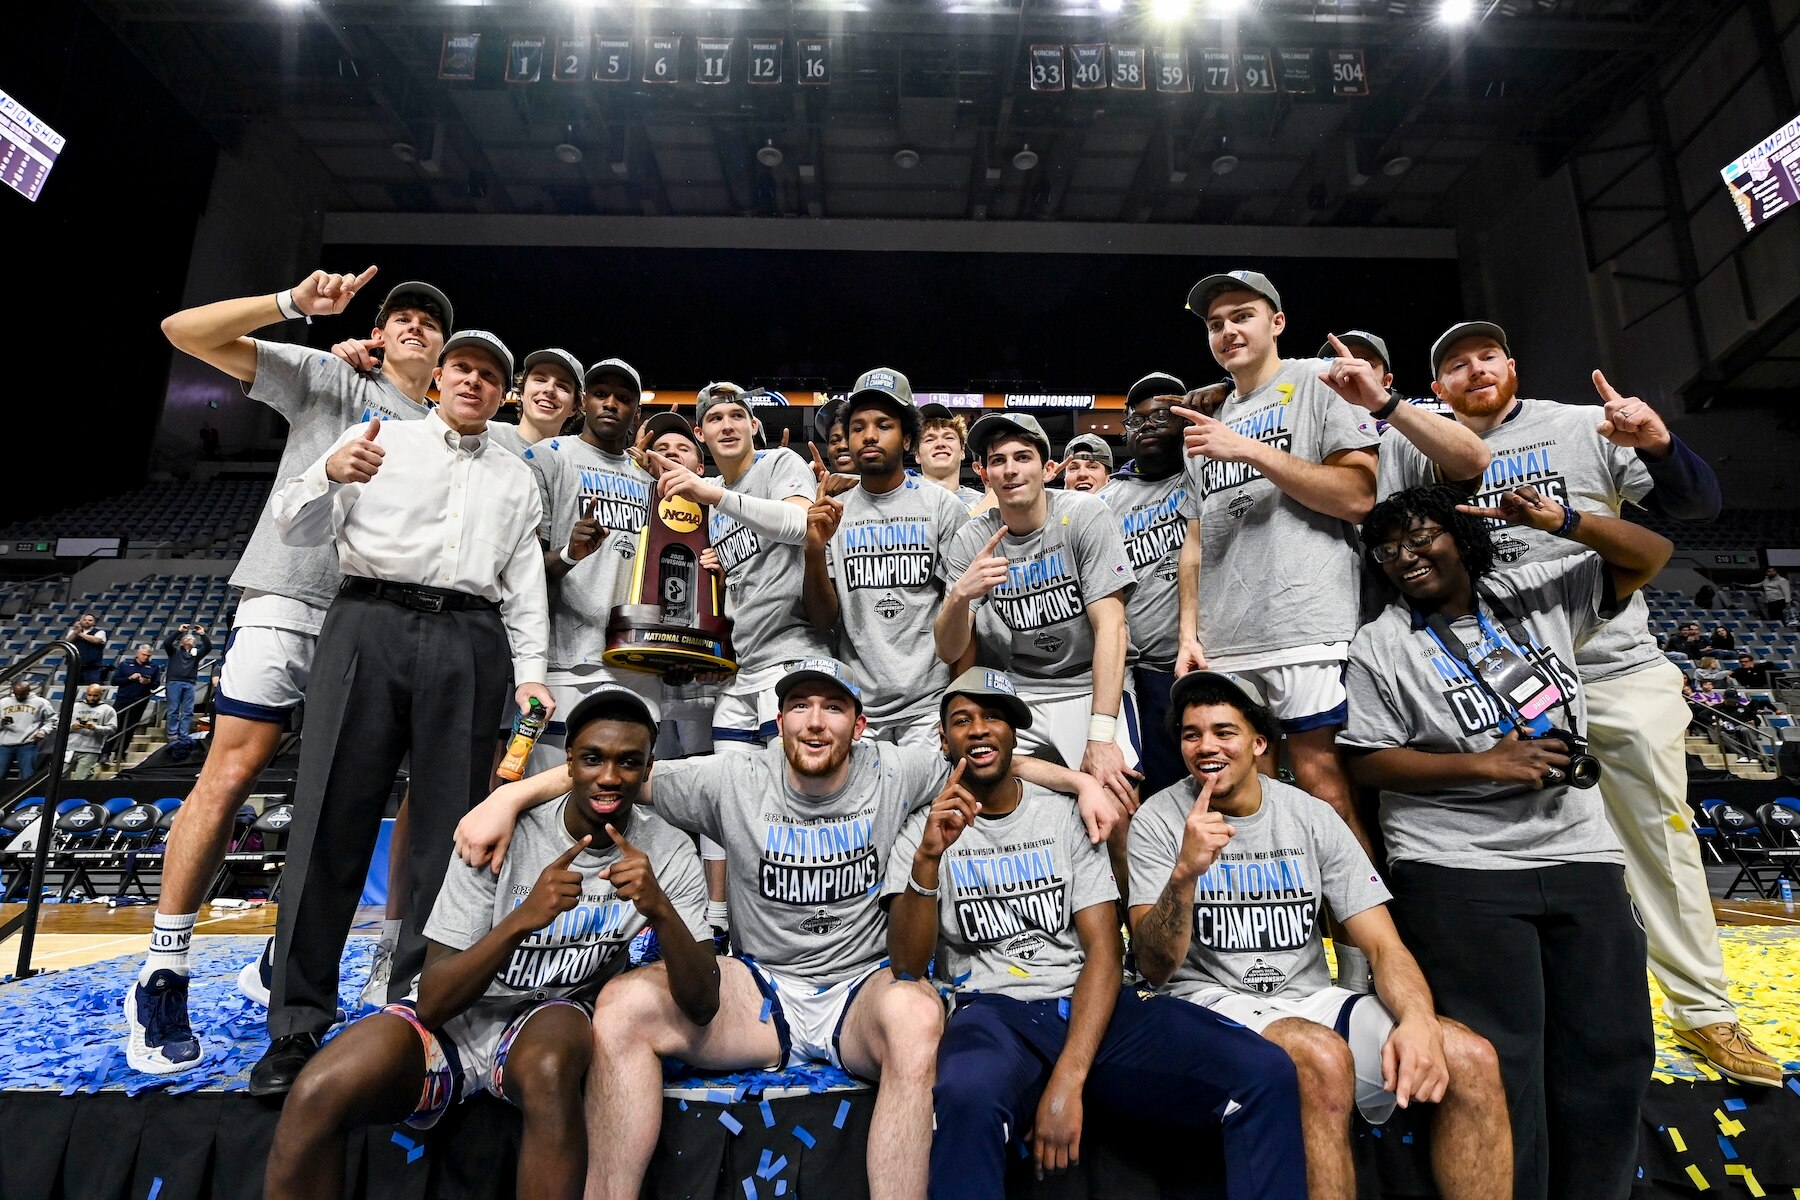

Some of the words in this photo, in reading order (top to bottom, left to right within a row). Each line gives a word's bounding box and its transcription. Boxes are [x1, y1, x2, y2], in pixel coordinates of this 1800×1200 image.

[519, 57, 528, 75] 1
[565, 55, 578, 73] 2
[608, 55, 620, 73] 5
[655, 57, 667, 76] 6
[704, 57, 724, 76] 11
[754, 58, 774, 77] 12
[806, 58, 825, 78] 16
[1076, 63, 1100, 82] 40
[1117, 63, 1139, 82] 58
[1333, 63, 1363, 82] 504
[1034, 65, 1060, 83] 33
[1162, 67, 1183, 85] 59
[1207, 67, 1230, 86] 77
[1246, 68, 1271, 88] 91
[870, 379, 895, 389] CHAMPIONS
[871, 373, 894, 381] NATIONAL
[952, 396, 966, 406] 60
[1518, 439, 1557, 453] BASKETBALL
[1483, 448, 1559, 492] IONAL
[662, 508, 701, 527] NCAA
[845, 524, 931, 555] NATIONAL
[660, 556, 687, 567] DIVISION
[846, 555, 931, 589] CHAMPIONS
[995, 583, 1083, 629] CHAMPIONS
[643, 631, 680, 643] NATIONAL
[681, 635, 717, 649] CHAMPIO
[3, 703, 37, 715] TRINITY
[1533, 694, 1551, 710] PHOTO
[764, 813, 780, 822] 2025
[765, 818, 875, 864] NATIONAL
[973, 846, 995, 856] DIVISION
[1003, 843, 1021, 853] MEN'S
[1022, 837, 1055, 850] BASKETBALL
[1221, 852, 1244, 861] DIVISION
[1269, 847, 1305, 859] BASKETBALL
[763, 854, 877, 903] CHAMPIONS
[950, 849, 1063, 897] NATIONAL
[1200, 859, 1313, 901] NATIONAL
[512, 885, 531, 896] 2025
[959, 889, 1063, 942] CHAMPIONS
[1197, 903, 1314, 950] CHAMPIONS
[499, 944, 620, 988] HAMPIONS
[1243, 976, 1286, 984] CHAMPIONSHIP
